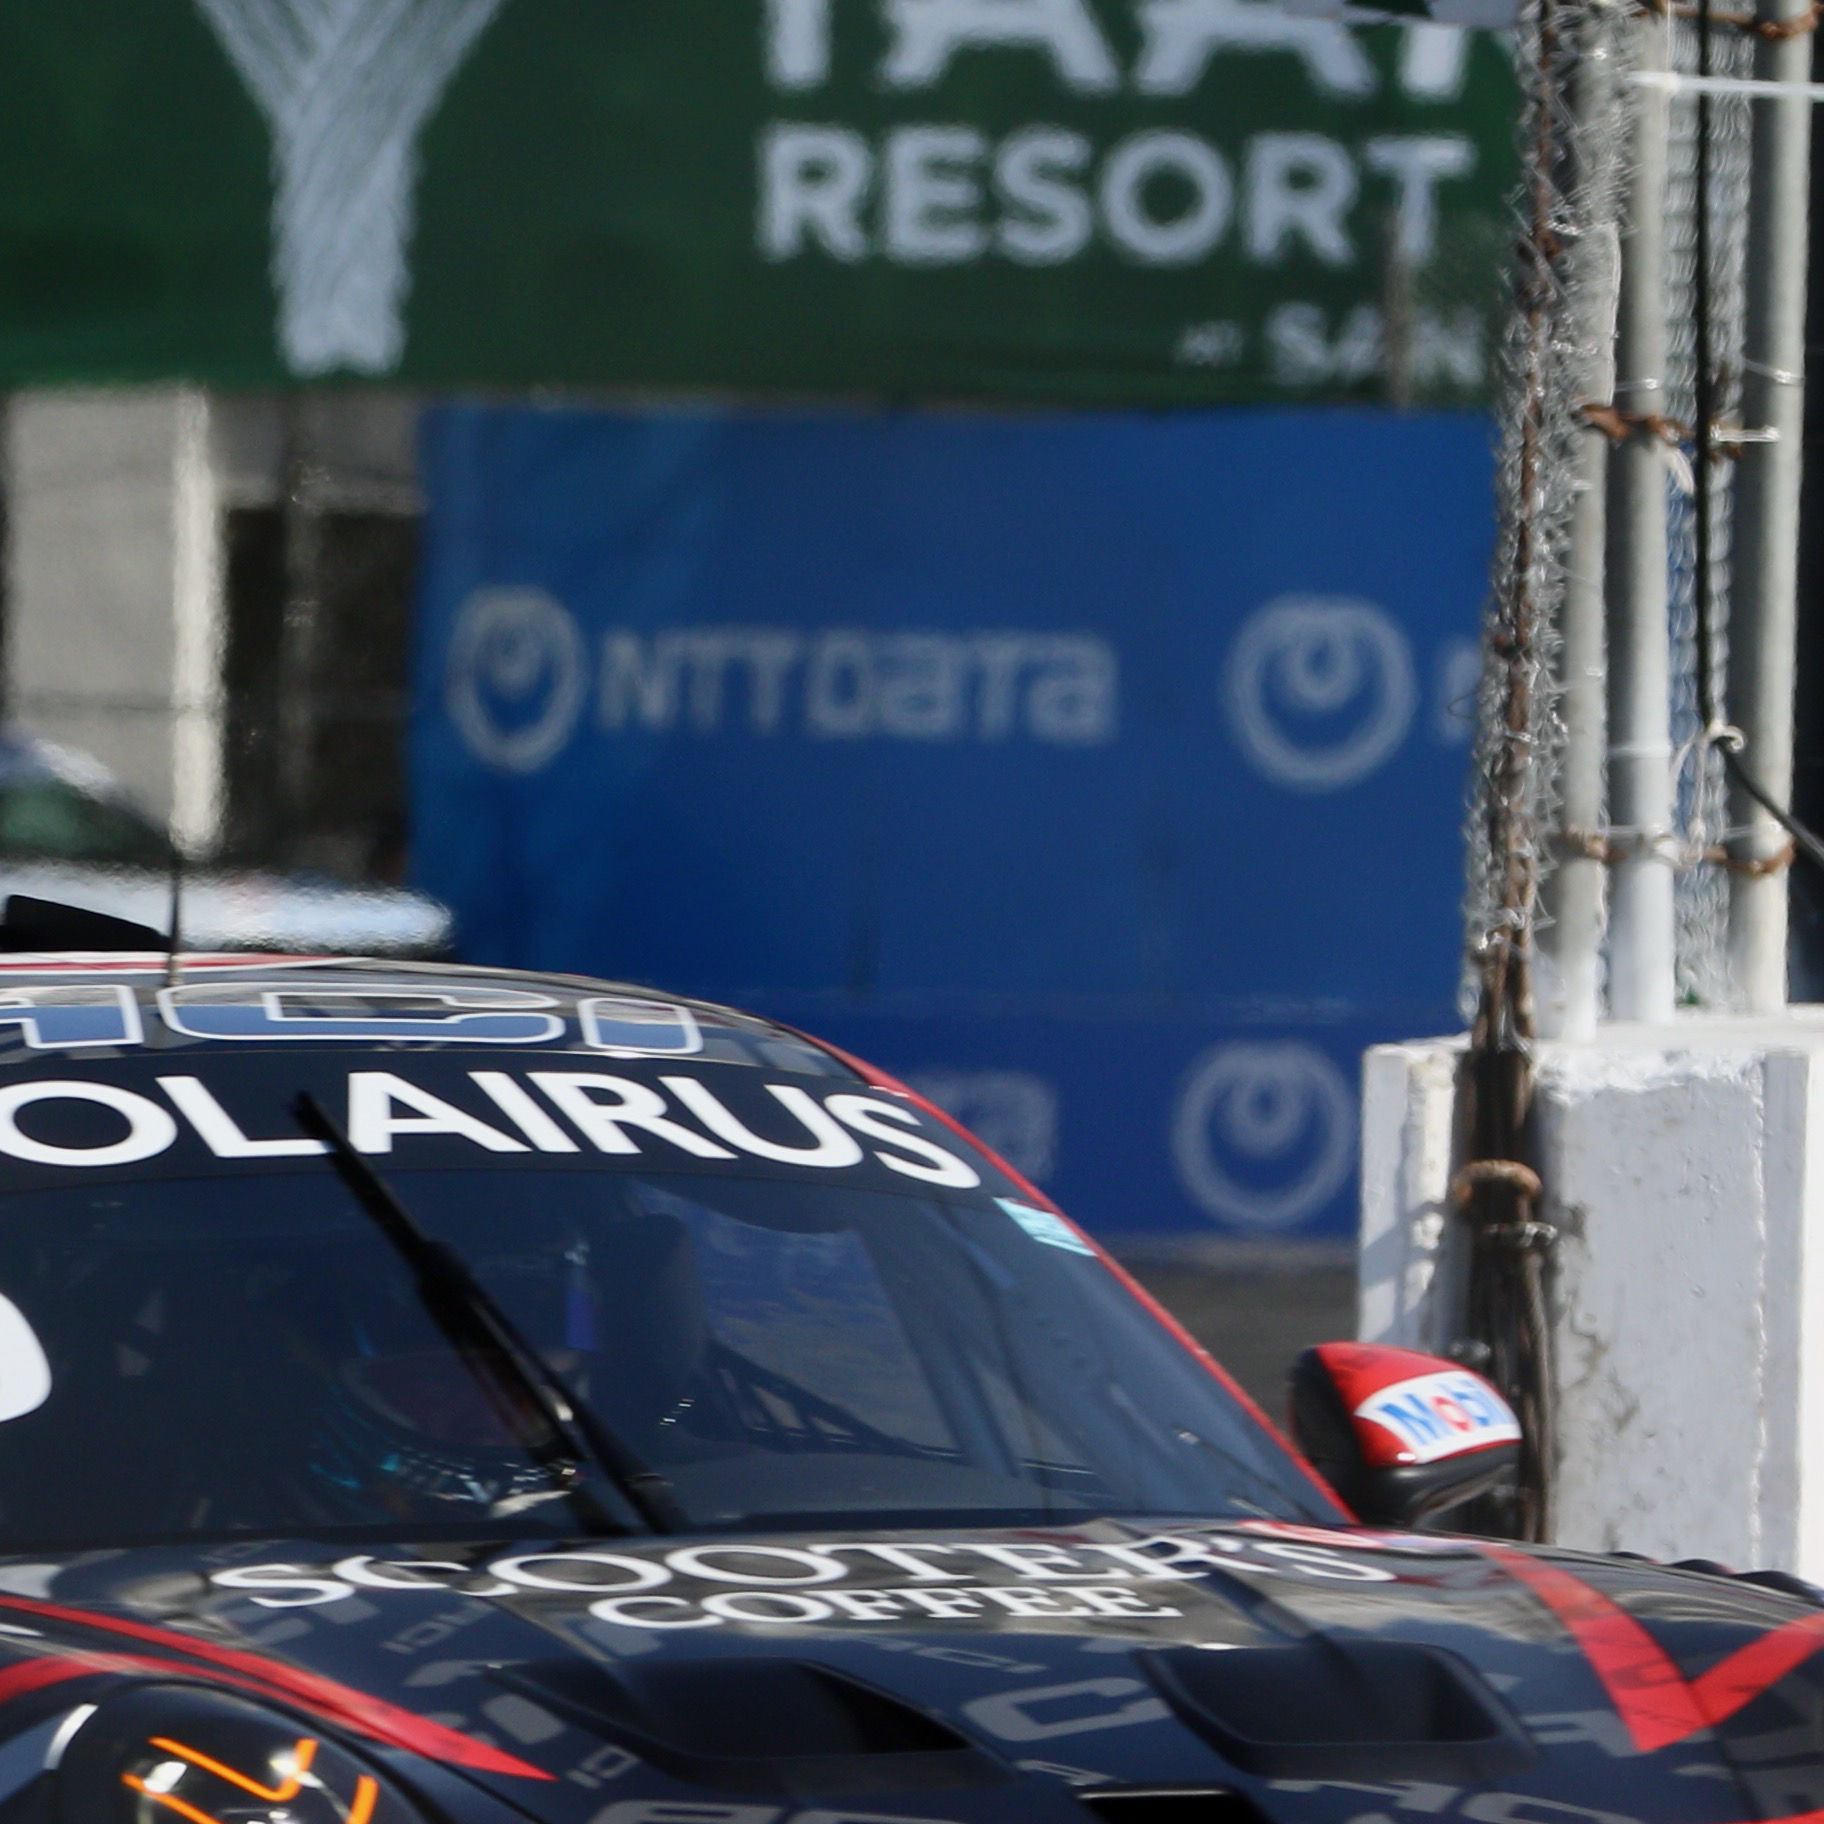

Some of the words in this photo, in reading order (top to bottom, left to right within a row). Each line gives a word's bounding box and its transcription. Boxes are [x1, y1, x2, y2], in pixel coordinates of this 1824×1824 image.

[757, 124, 1478, 268] RESORT
[211, 1535, 1398, 1608] SCOOTER'S
[588, 1583, 1184, 1630] COFFEE
